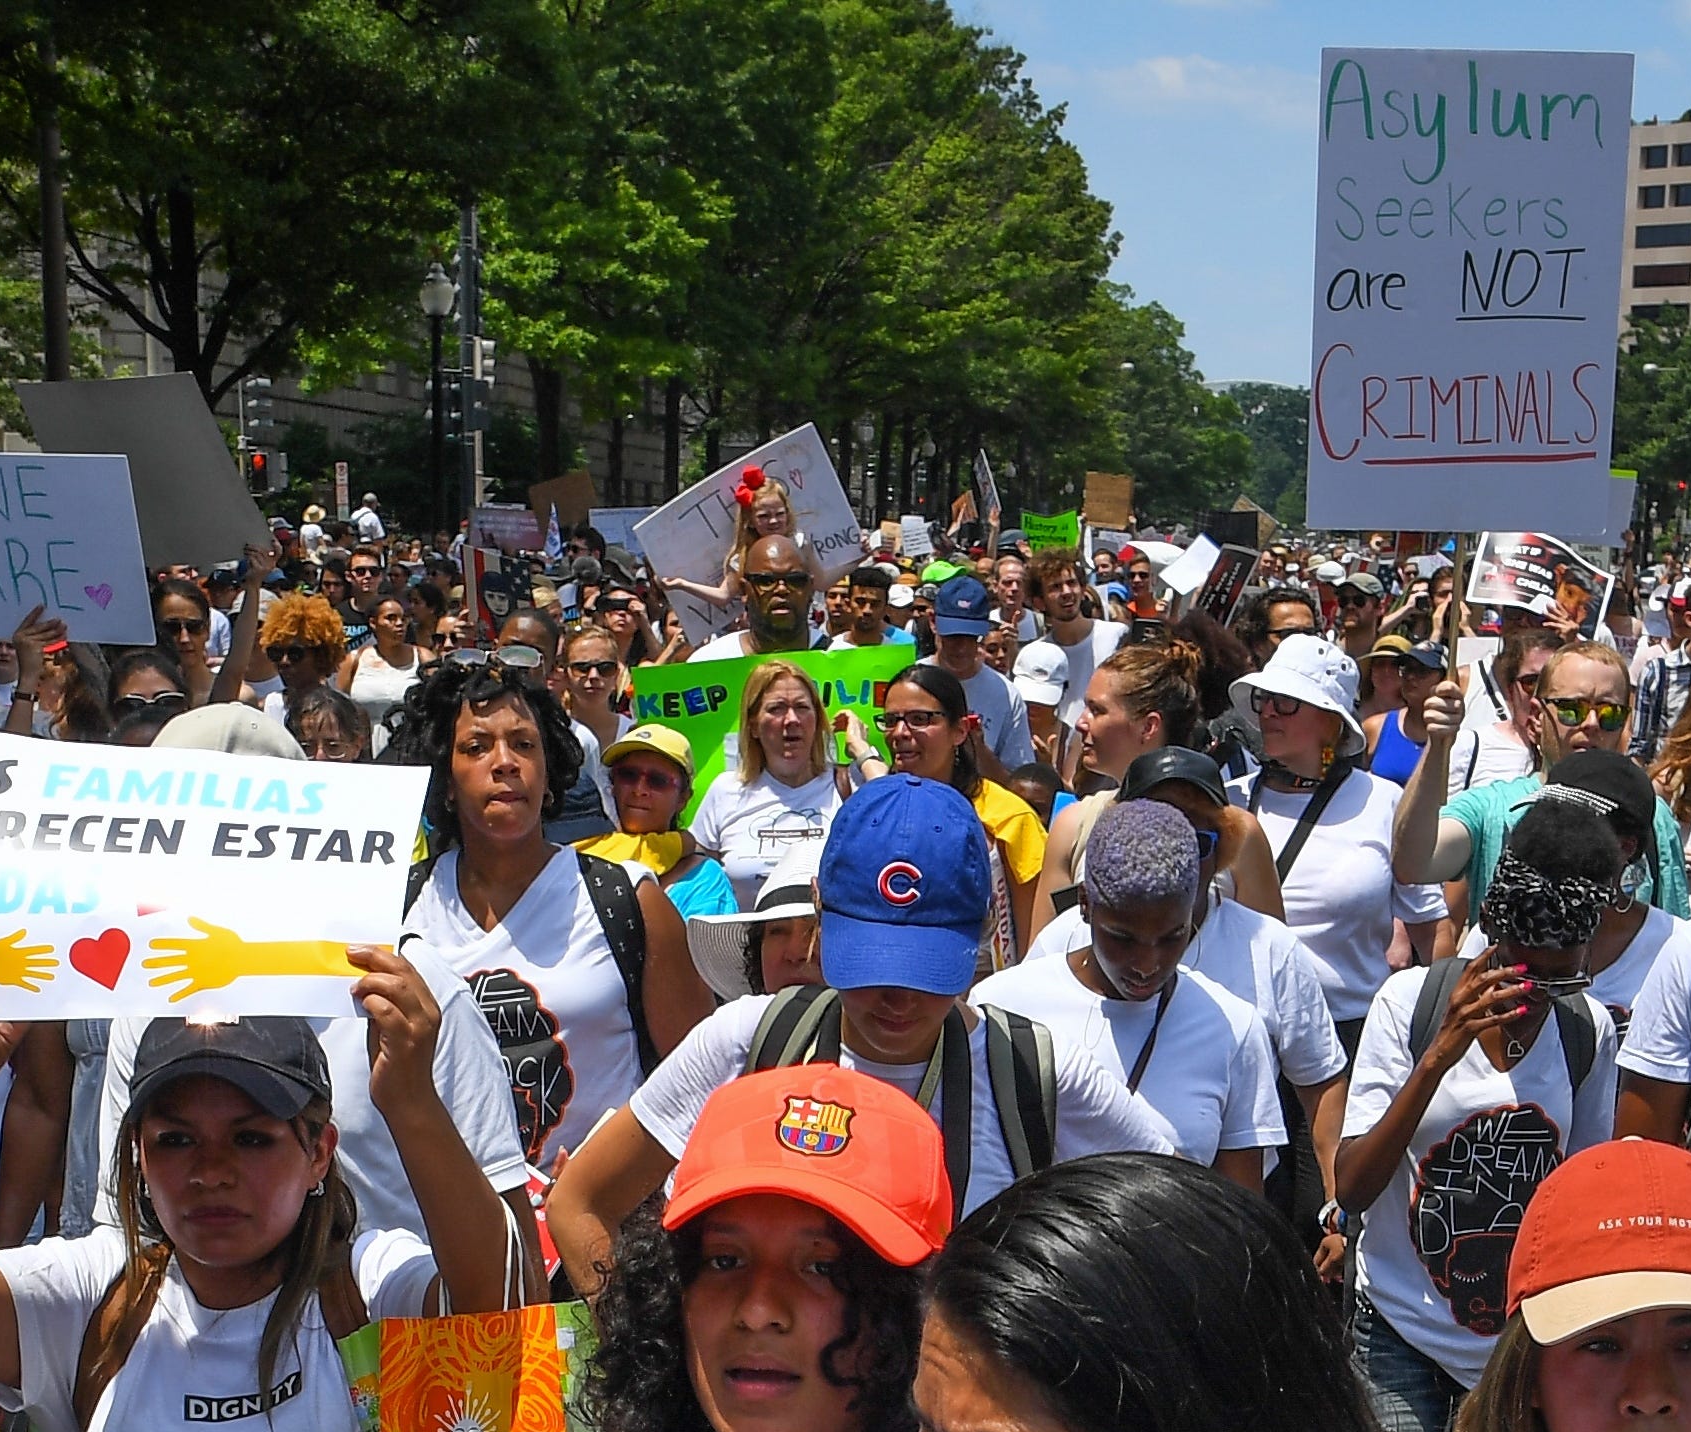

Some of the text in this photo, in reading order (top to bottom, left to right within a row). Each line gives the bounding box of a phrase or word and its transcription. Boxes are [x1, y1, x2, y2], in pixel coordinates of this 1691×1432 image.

[1324, 58, 1604, 186] Asylum
[1335, 177, 1569, 241] Seekers
[1326, 247, 1585, 313] are NOT
[1313, 343, 1601, 463] CRIMINALS
[638, 678, 890, 719] KEEP ILIE
[42, 764, 328, 815] FAMILIAS
[211, 822, 396, 866] ESTAR
[1476, 1109, 1553, 1143] WE
[1448, 1132, 1561, 1183] DREAM
[1431, 1166, 1513, 1202] IN
[1418, 1191, 1525, 1255] BLA
[1598, 1218, 1623, 1230] ASK
[1628, 1216, 1663, 1226] YOUR
[189, 1375, 297, 1420] DIGNTY
